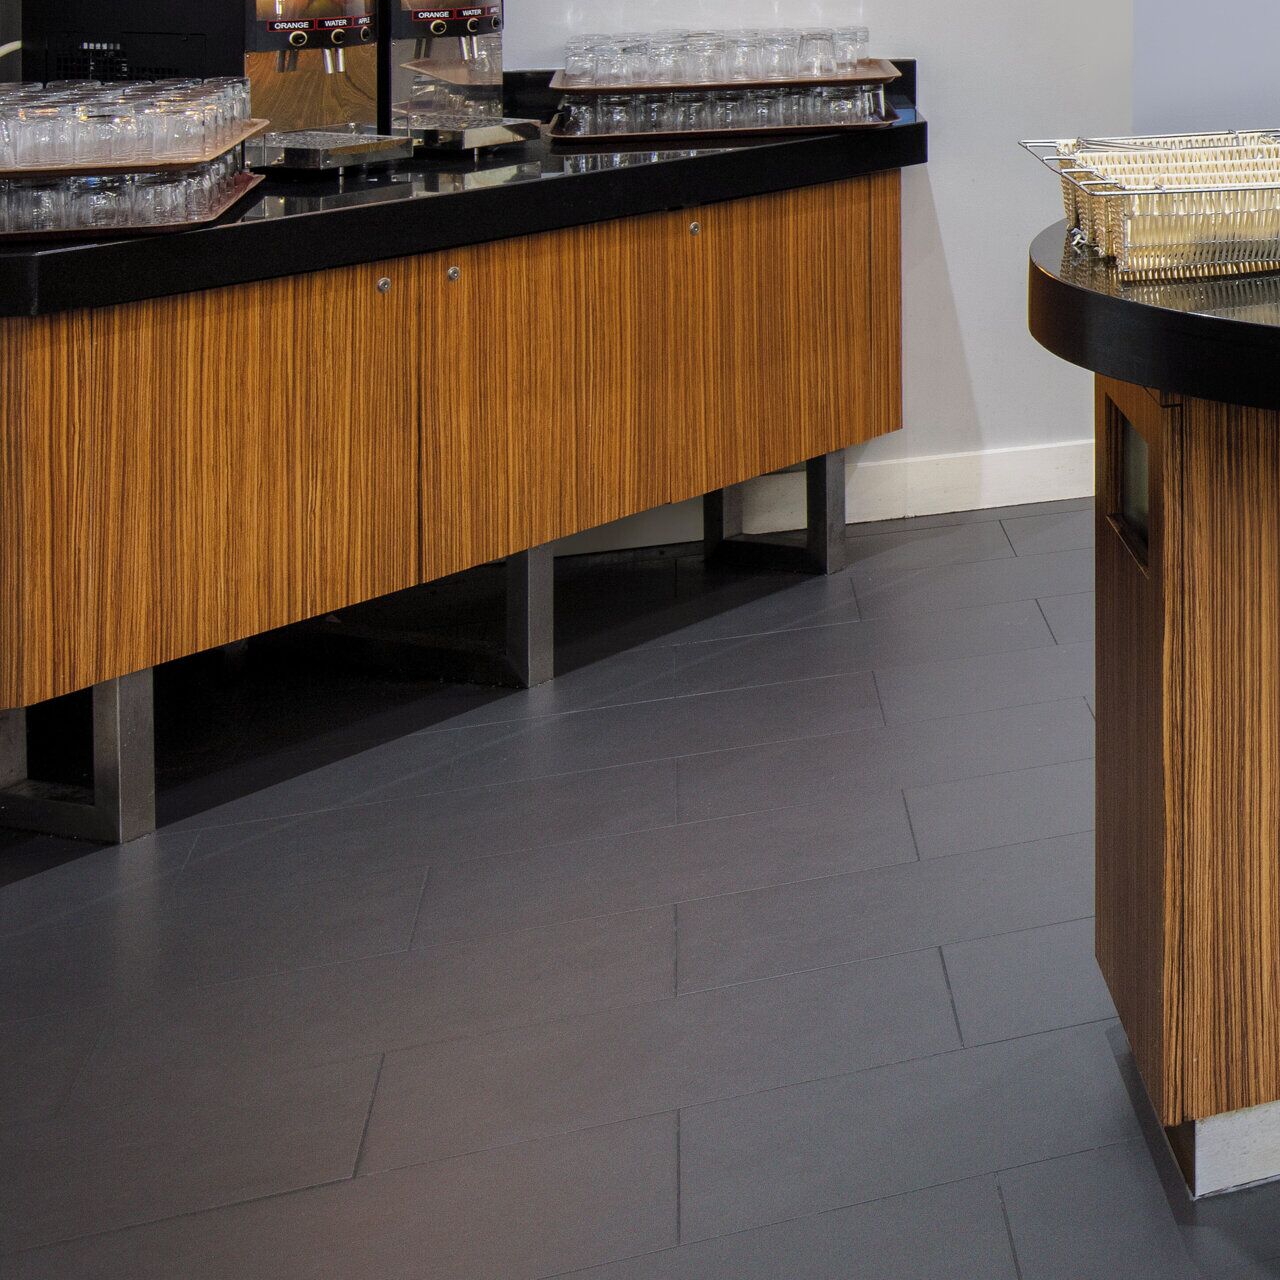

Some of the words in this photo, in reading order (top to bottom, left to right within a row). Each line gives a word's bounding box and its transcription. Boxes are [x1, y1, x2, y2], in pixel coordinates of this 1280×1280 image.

[418, 10, 450, 19] ORANGE
[462, 8, 482, 17] WATER
[324, 19, 348, 28] WATER
[357, 16, 371, 25] APPLE
[274, 21, 310, 30] ORANGE
